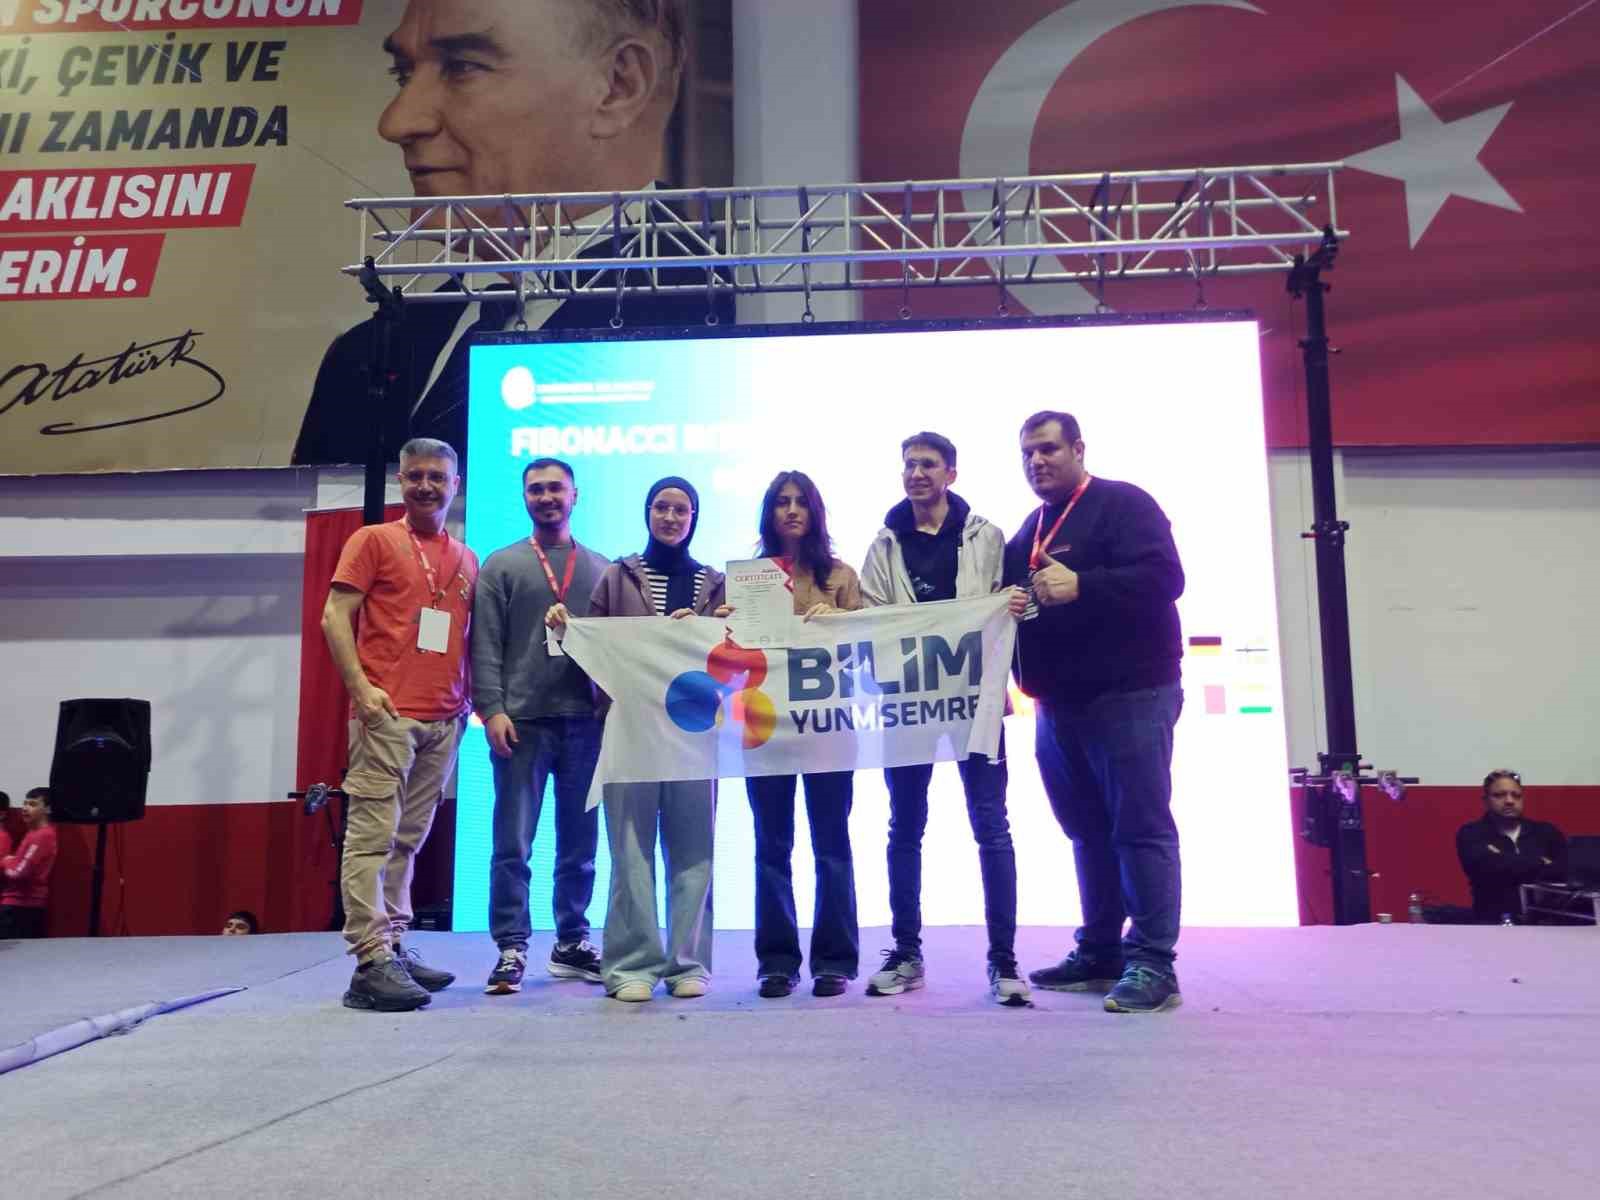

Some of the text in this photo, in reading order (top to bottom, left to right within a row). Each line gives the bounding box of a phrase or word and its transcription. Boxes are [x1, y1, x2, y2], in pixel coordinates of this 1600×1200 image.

[57, 32, 212, 97] ÇEVİK
[225, 41, 287, 83] VE
[38, 105, 288, 153] ZAMANDA
[0, 172, 232, 221] AKLISINI
[0, 235, 137, 294] ERİM.
[510, 424, 678, 457] FIBONACCI
